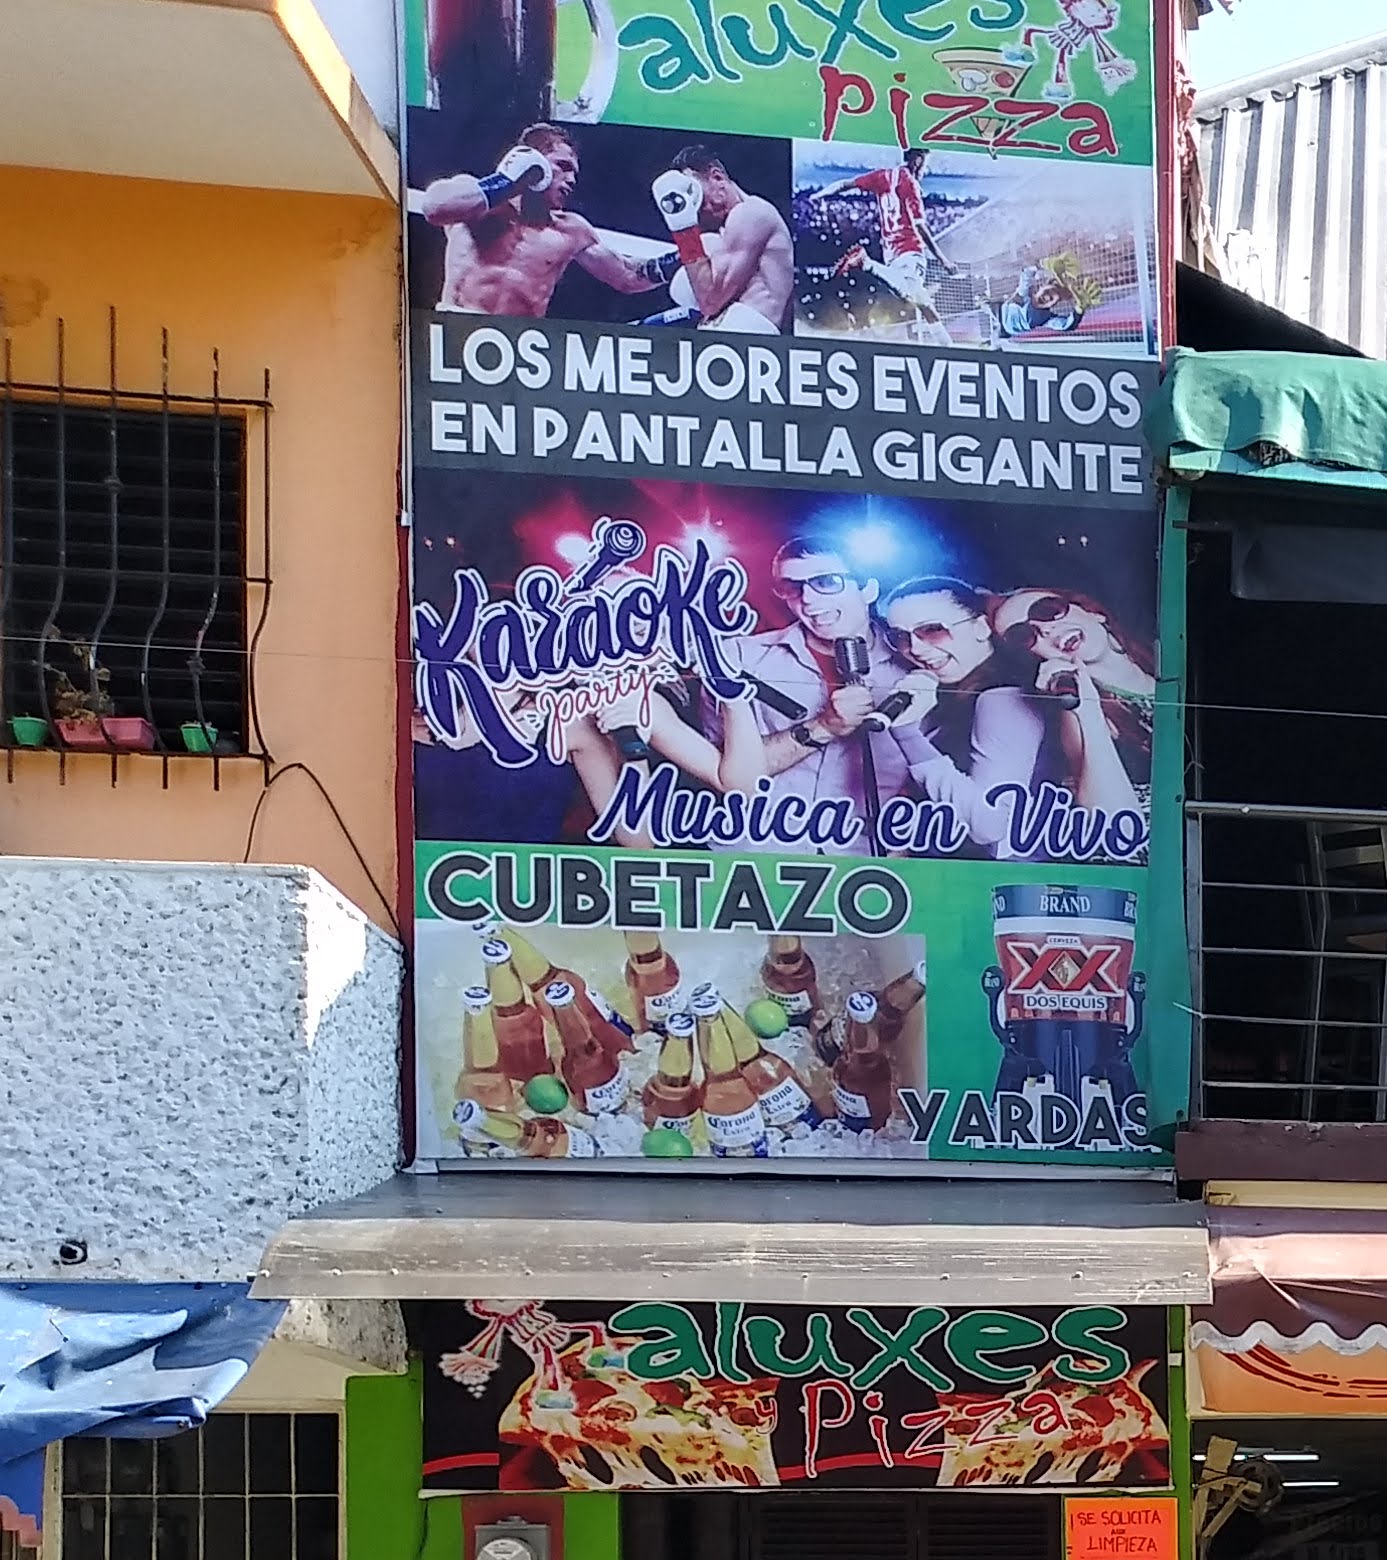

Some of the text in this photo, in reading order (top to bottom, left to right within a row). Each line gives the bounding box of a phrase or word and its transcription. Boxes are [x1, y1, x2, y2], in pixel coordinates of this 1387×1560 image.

[819, 62, 1117, 155] pizza
[429, 323, 1142, 429] LOS MEJORES EVENTOS
[430, 401, 1144, 495] EN PANTALLA GIGANTE
[414, 539, 751, 767] Karaoke
[535, 658, 659, 759] party
[589, 767, 1149, 862] Musica en Vivo
[426, 853, 910, 937] CUBETAZO
[1040, 895, 1090, 913] BRAND
[1026, 996, 1105, 1009] DOS EQUIS
[900, 1087, 1151, 1151] YARDAS
[607, 1302, 1131, 1392] aluxes
[753, 1380, 1069, 1478] y Pizza
[1077, 1510, 1161, 1526] SE SOLICITA
[1087, 1536, 1158, 1553] LIMPIEZA
